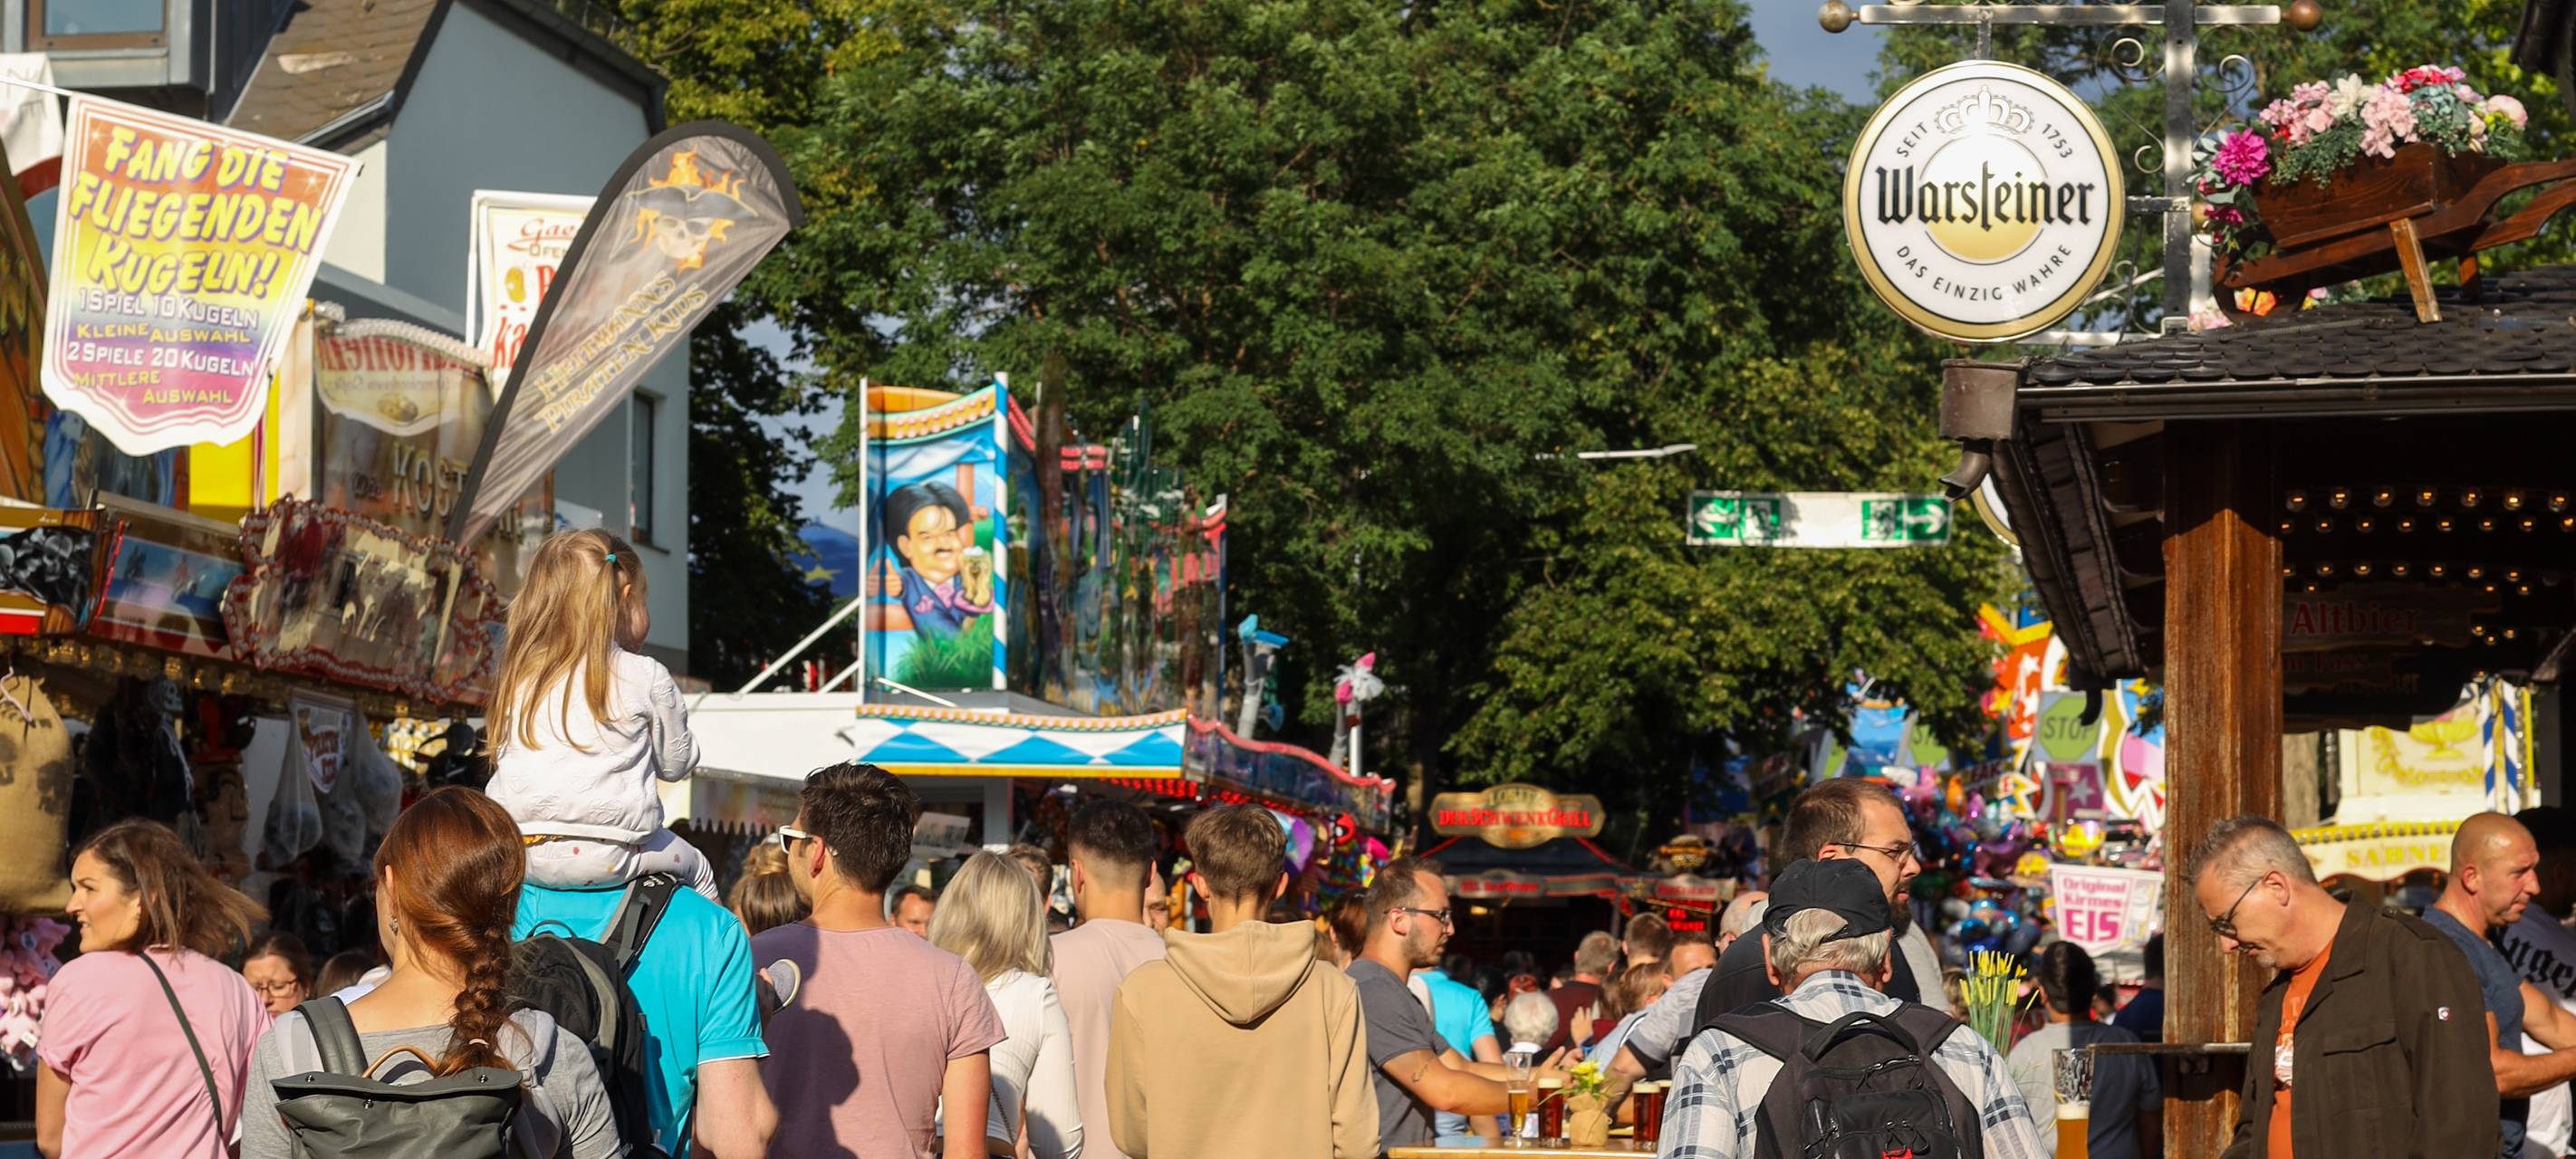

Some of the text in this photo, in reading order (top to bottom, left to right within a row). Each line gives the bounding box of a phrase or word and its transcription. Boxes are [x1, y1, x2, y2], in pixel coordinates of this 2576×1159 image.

[1897, 121, 2073, 158] SEIT 1753
[104, 125, 288, 192] FANG DIE
[69, 170, 323, 255] FLIEGENDEN
[1875, 160, 2095, 232] Warsteiner
[89, 230, 280, 298] KUGELN!
[1897, 244, 2071, 302] DAS EINZIG WAHRE
[153, 295, 177, 317] 10
[178, 297, 260, 330] KUGELN
[76, 322, 251, 344] KLEINE AUSWAHL
[68, 341, 255, 376] 2 SPIELE 20 KUGELN
[533, 332, 655, 435] PIRATEN
[642, 283, 708, 341] KIDS
[74, 369, 160, 388] MITTLERE
[143, 388, 233, 406] AUSWAHL
[2291, 600, 2421, 636] Altbier
[2347, 843, 2446, 869] SAHNE
[2063, 878, 2126, 894] Original
[2064, 909, 2120, 942] EIS
